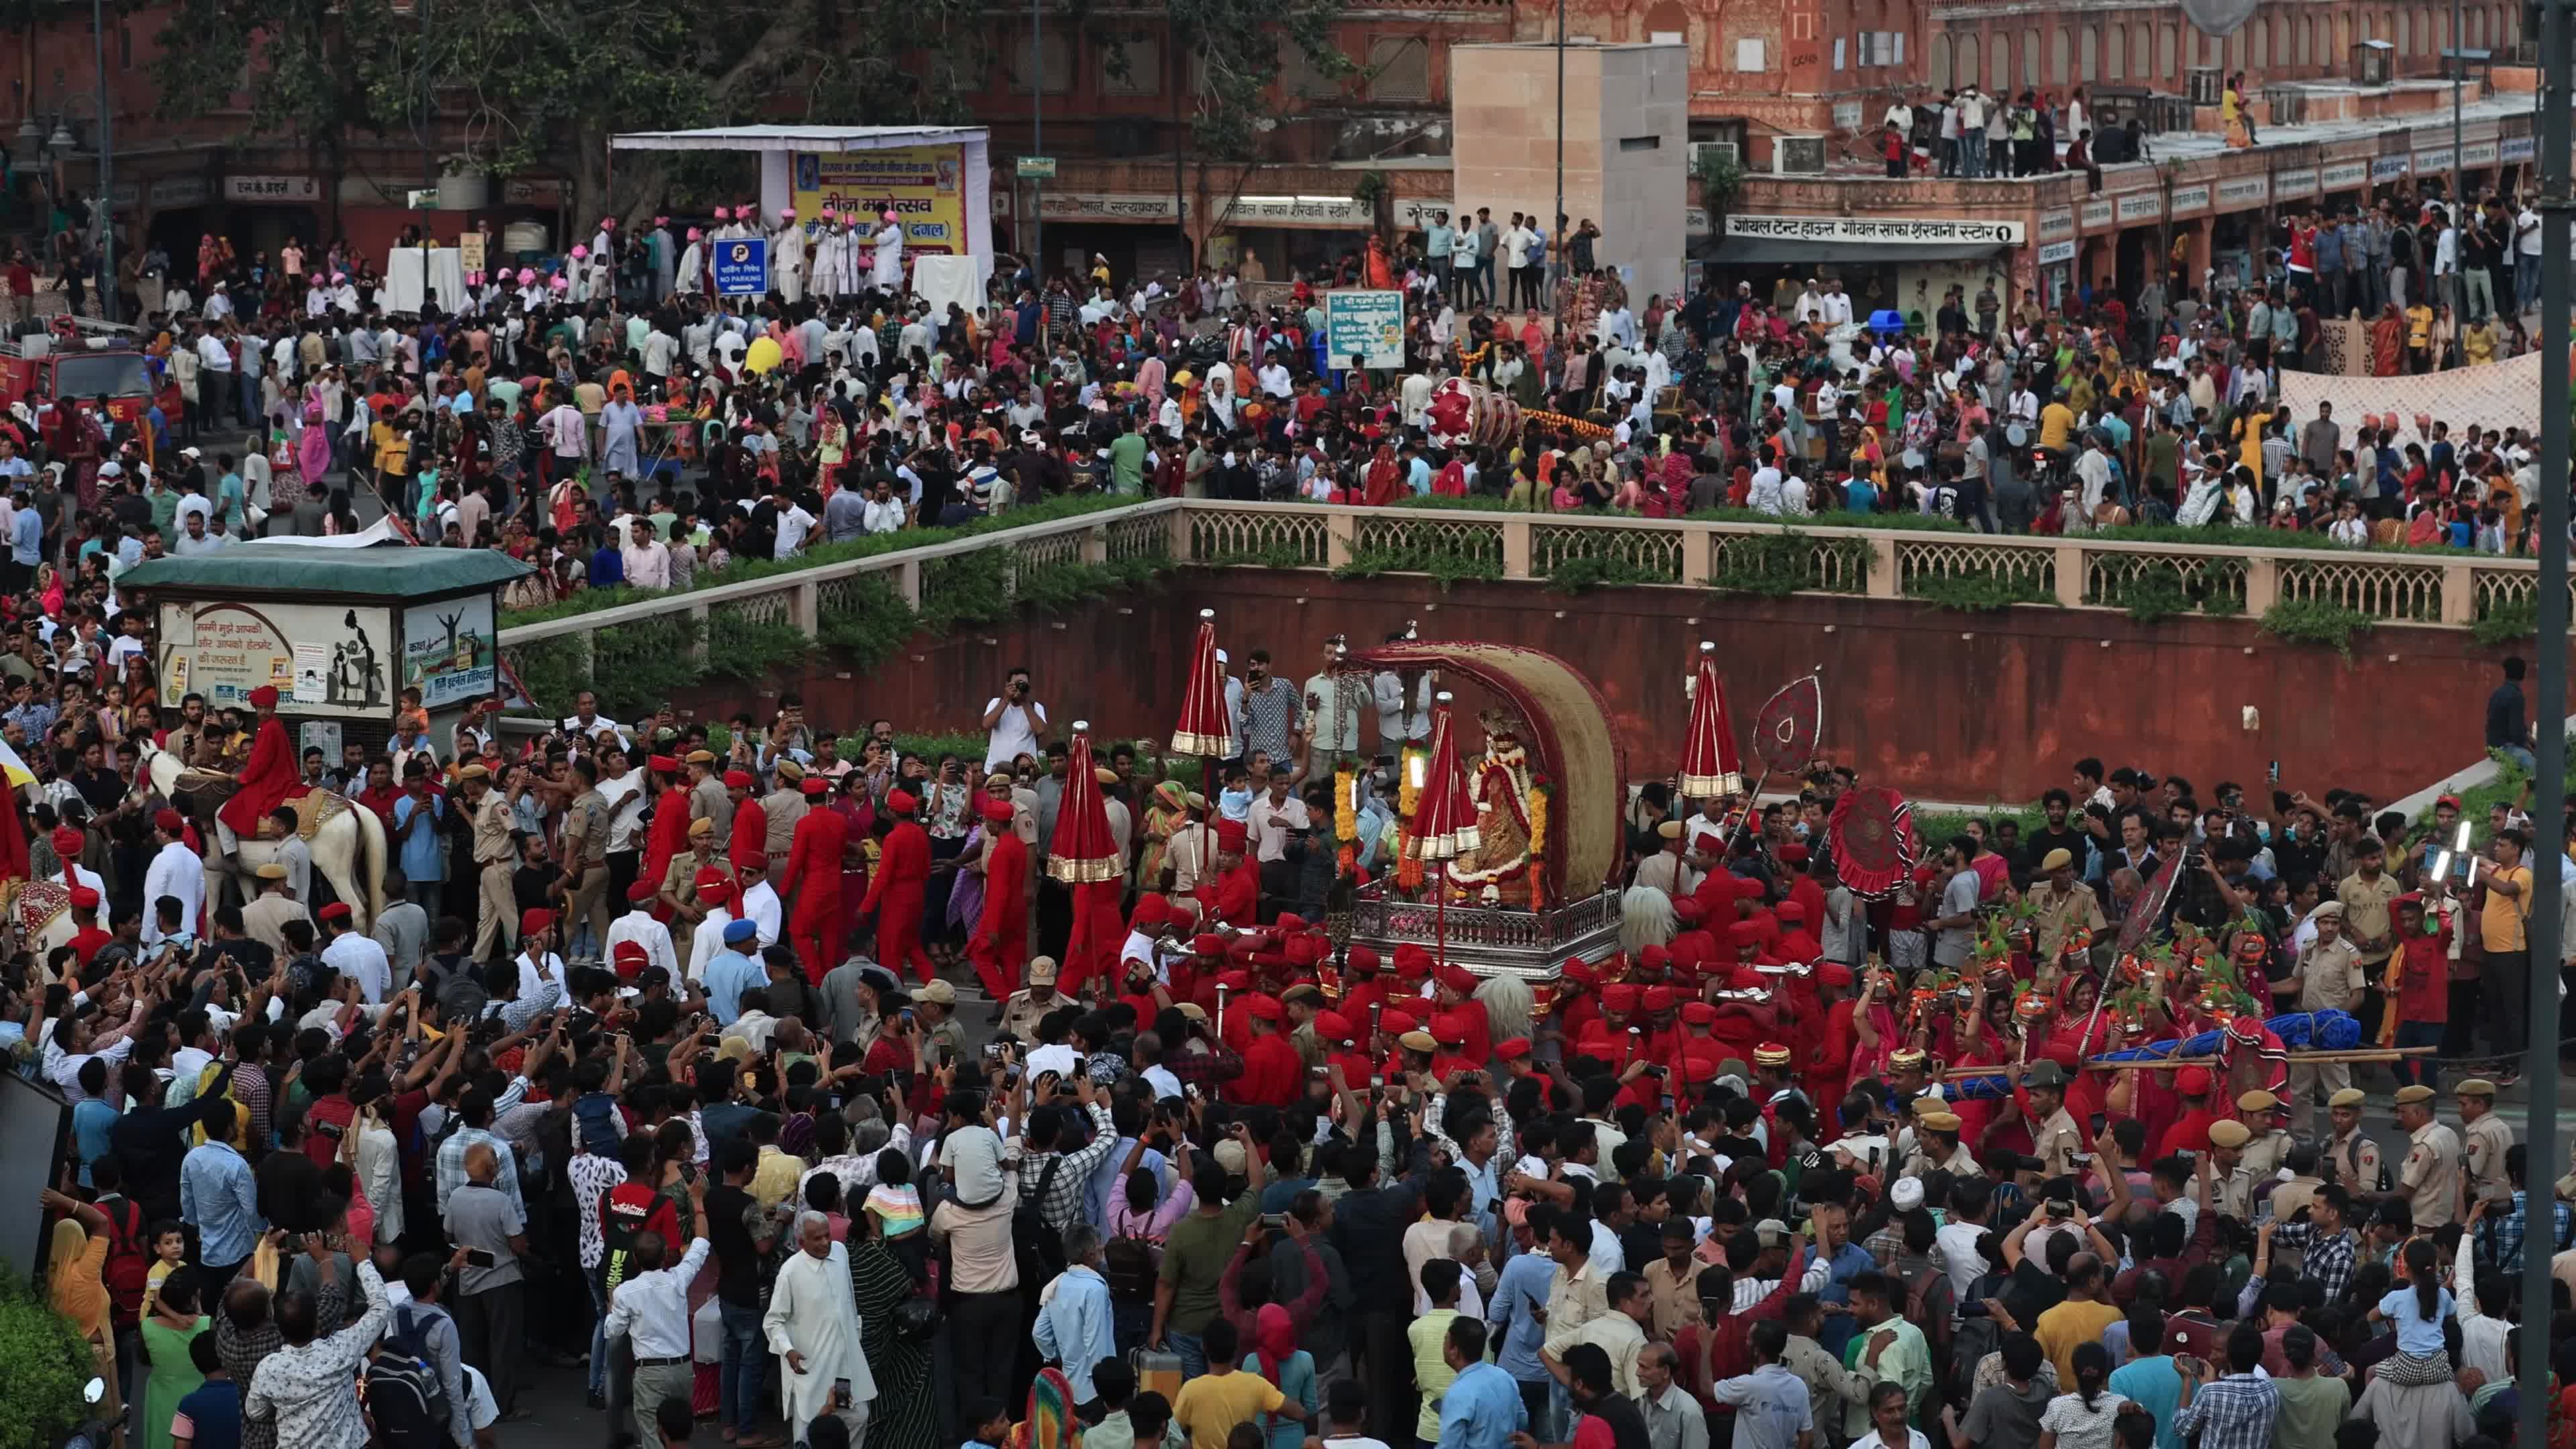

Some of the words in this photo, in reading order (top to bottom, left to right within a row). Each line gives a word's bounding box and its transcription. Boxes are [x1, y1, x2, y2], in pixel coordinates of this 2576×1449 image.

[1262, 204, 1287, 215] साफा
[1291, 203, 1324, 217] शेरवानी
[1734, 219, 1771, 235] गोयल
[1801, 221, 1837, 239] हाऊस
[1842, 222, 1877, 237] गोयल
[1880, 223, 1909, 238] साफा
[1911, 220, 1956, 239] शेरवानी
[1960, 223, 1994, 240] स्टोर
[198, 636, 212, 649] और
[198, 652, 209, 663] की
[239, 654, 247, 665] है
